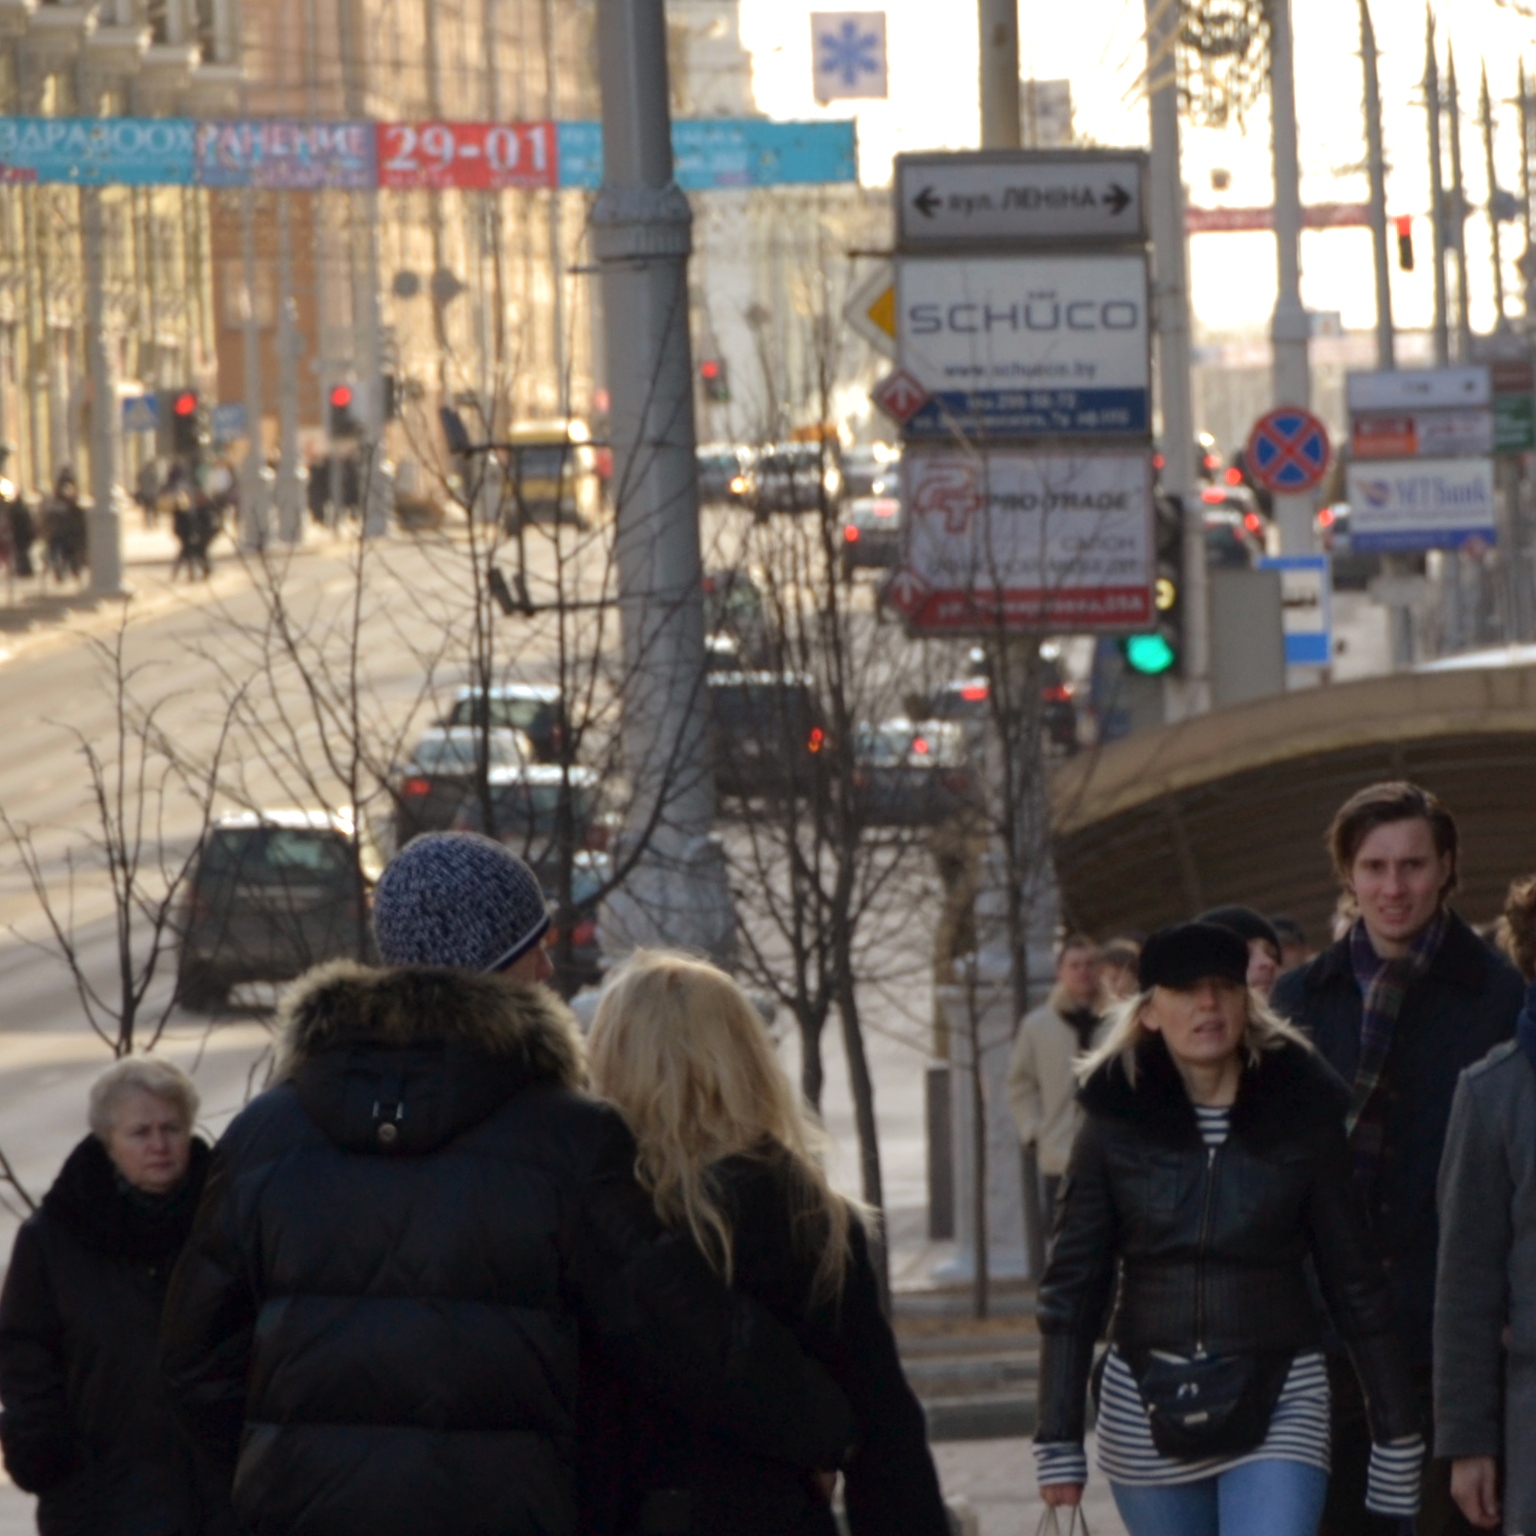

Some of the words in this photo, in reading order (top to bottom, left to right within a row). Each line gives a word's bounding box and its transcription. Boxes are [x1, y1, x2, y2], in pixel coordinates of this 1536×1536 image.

[385, 125, 548, 171] 29-01
[1001, 186, 1098, 210] ЛЕНІНА
[908, 290, 1138, 334] SCHÜCO
